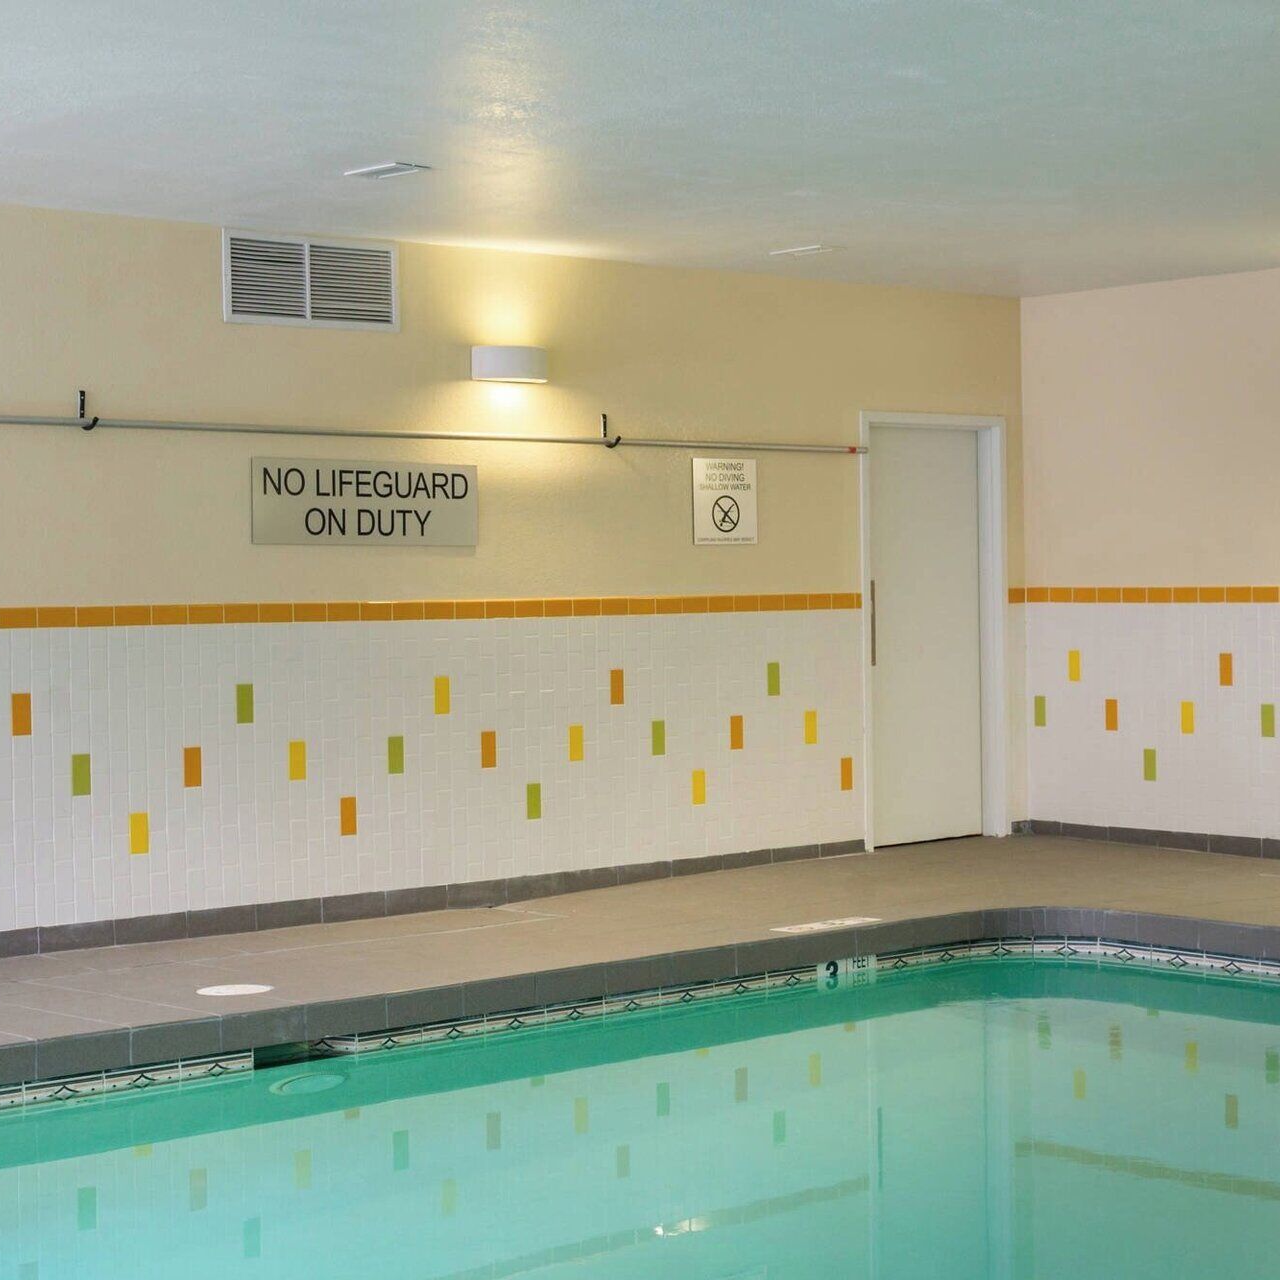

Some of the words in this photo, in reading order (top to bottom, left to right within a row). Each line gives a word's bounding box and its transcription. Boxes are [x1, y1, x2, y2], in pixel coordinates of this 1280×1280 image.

[262, 467, 305, 496] NO
[315, 469, 469, 500] LIFEGUARD
[705, 473, 717, 482] NO
[719, 474, 746, 482] DIVING
[304, 507, 346, 536] ON
[357, 508, 431, 537] DUTY
